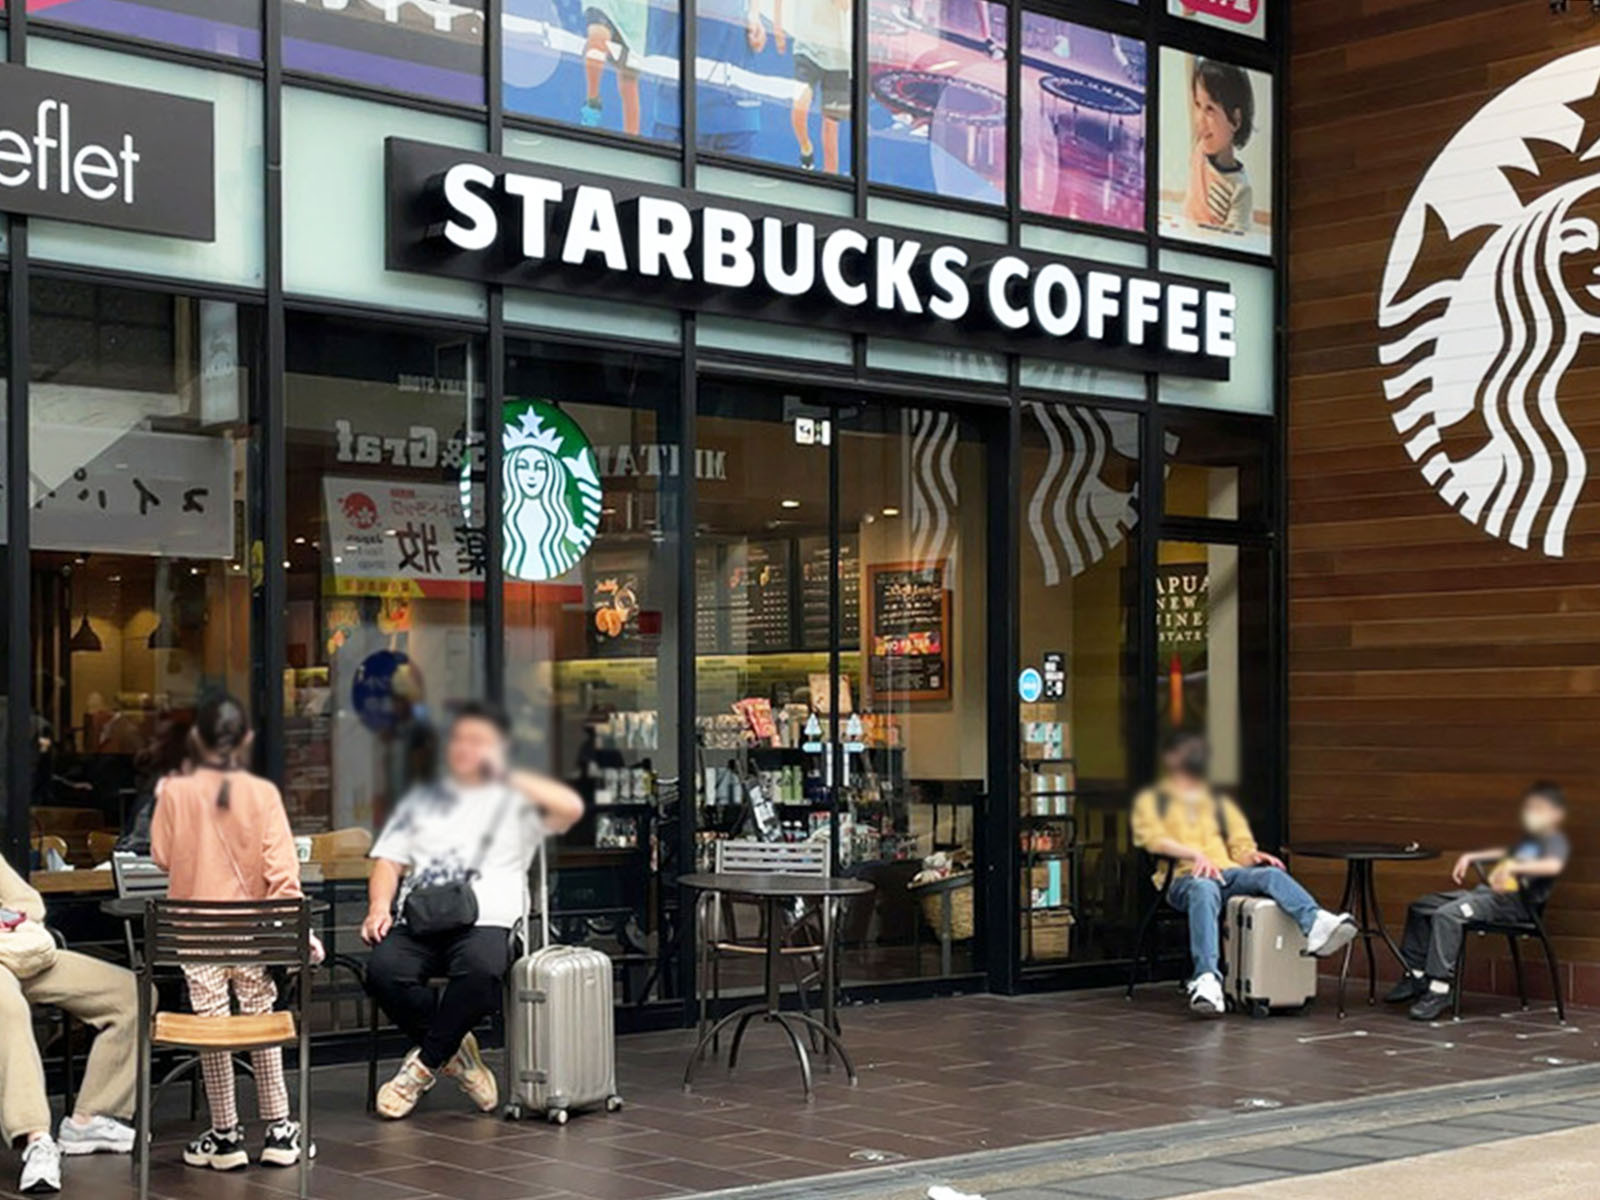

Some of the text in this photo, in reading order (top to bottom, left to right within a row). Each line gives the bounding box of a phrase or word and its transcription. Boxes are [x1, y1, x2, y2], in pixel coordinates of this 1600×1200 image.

[0, 99, 141, 204] eflet
[444, 164, 1238, 359] STARBUCKS COFFEE
